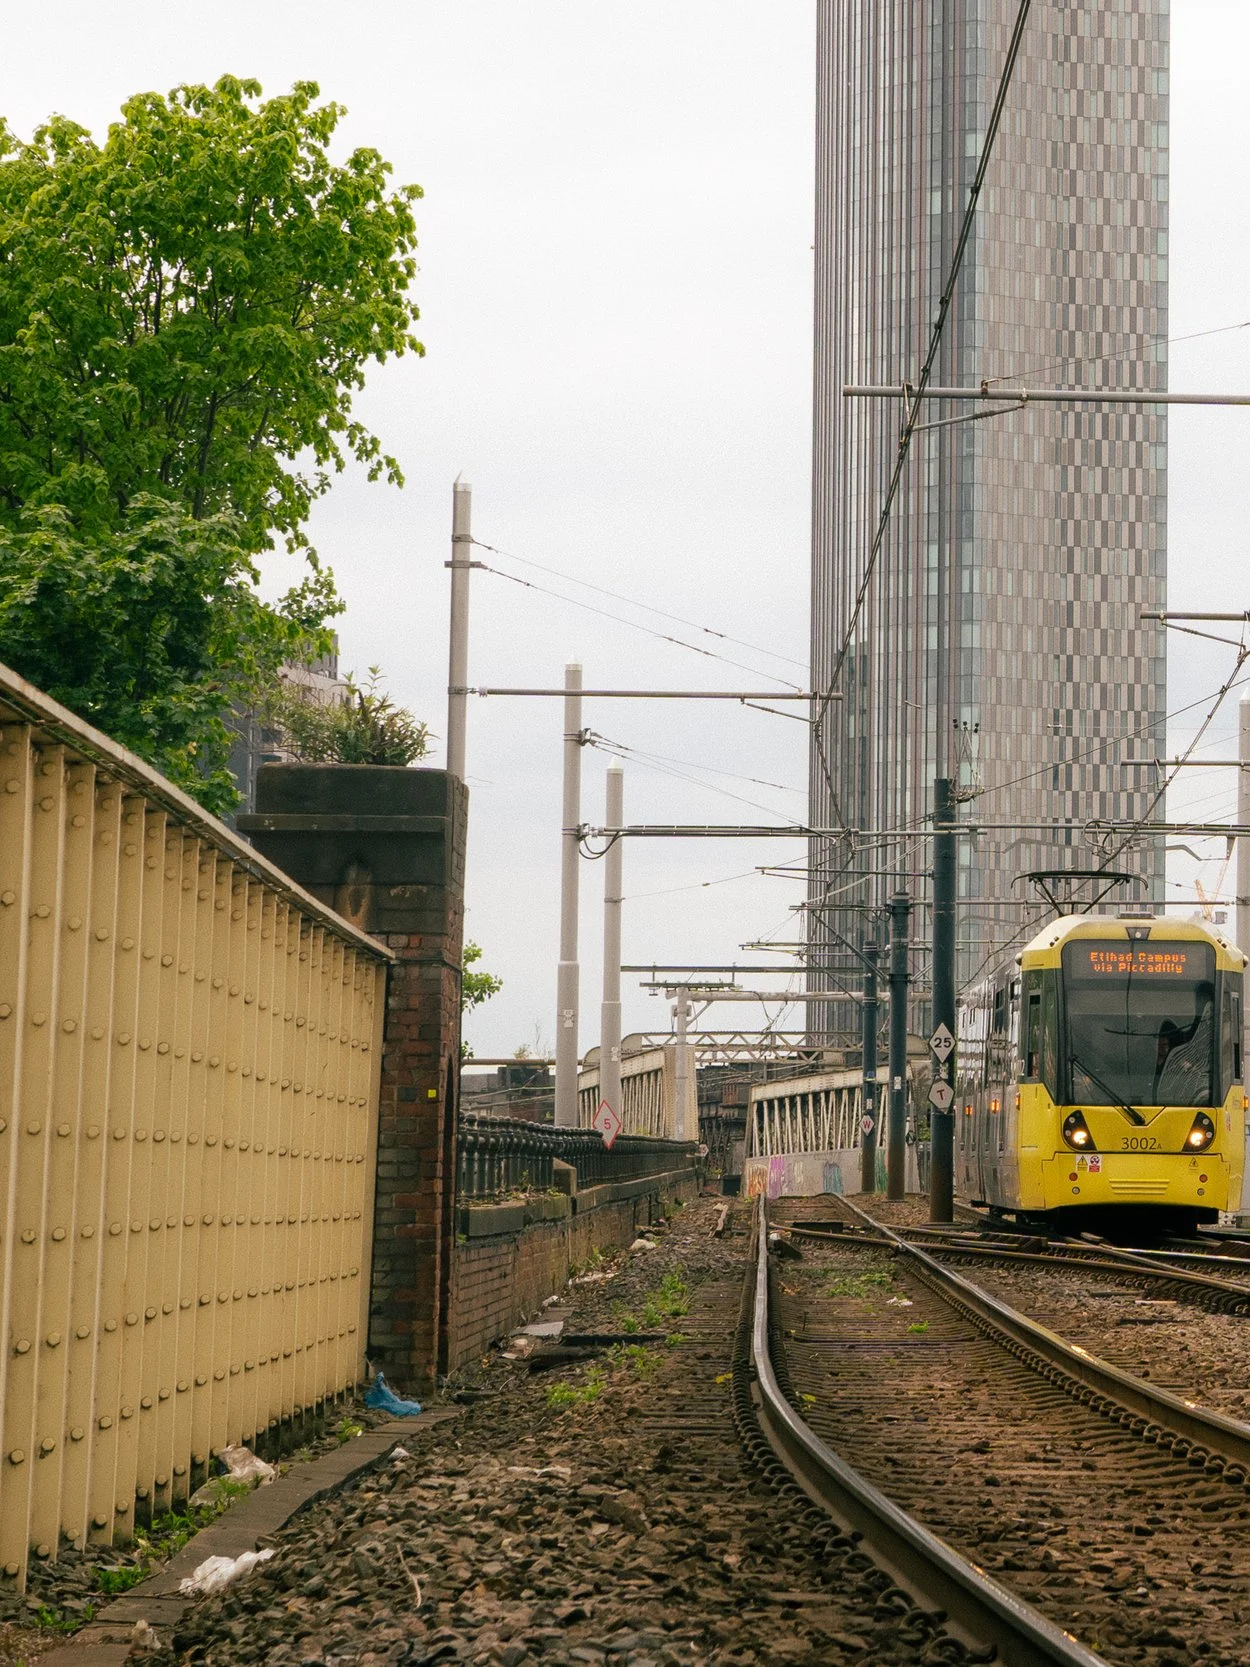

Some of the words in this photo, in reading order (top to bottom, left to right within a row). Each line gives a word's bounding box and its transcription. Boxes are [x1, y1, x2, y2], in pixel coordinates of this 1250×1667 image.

[1090, 952, 1133, 962] Etihad
[1138, 952, 1186, 963] Campus
[1094, 963, 1113, 973] via
[1118, 963, 1183, 974] Piccadilly
[934, 1037, 952, 1048] 25
[936, 1089, 945, 1100] T
[603, 1118, 611, 1130] 5
[863, 1121, 871, 1129] W
